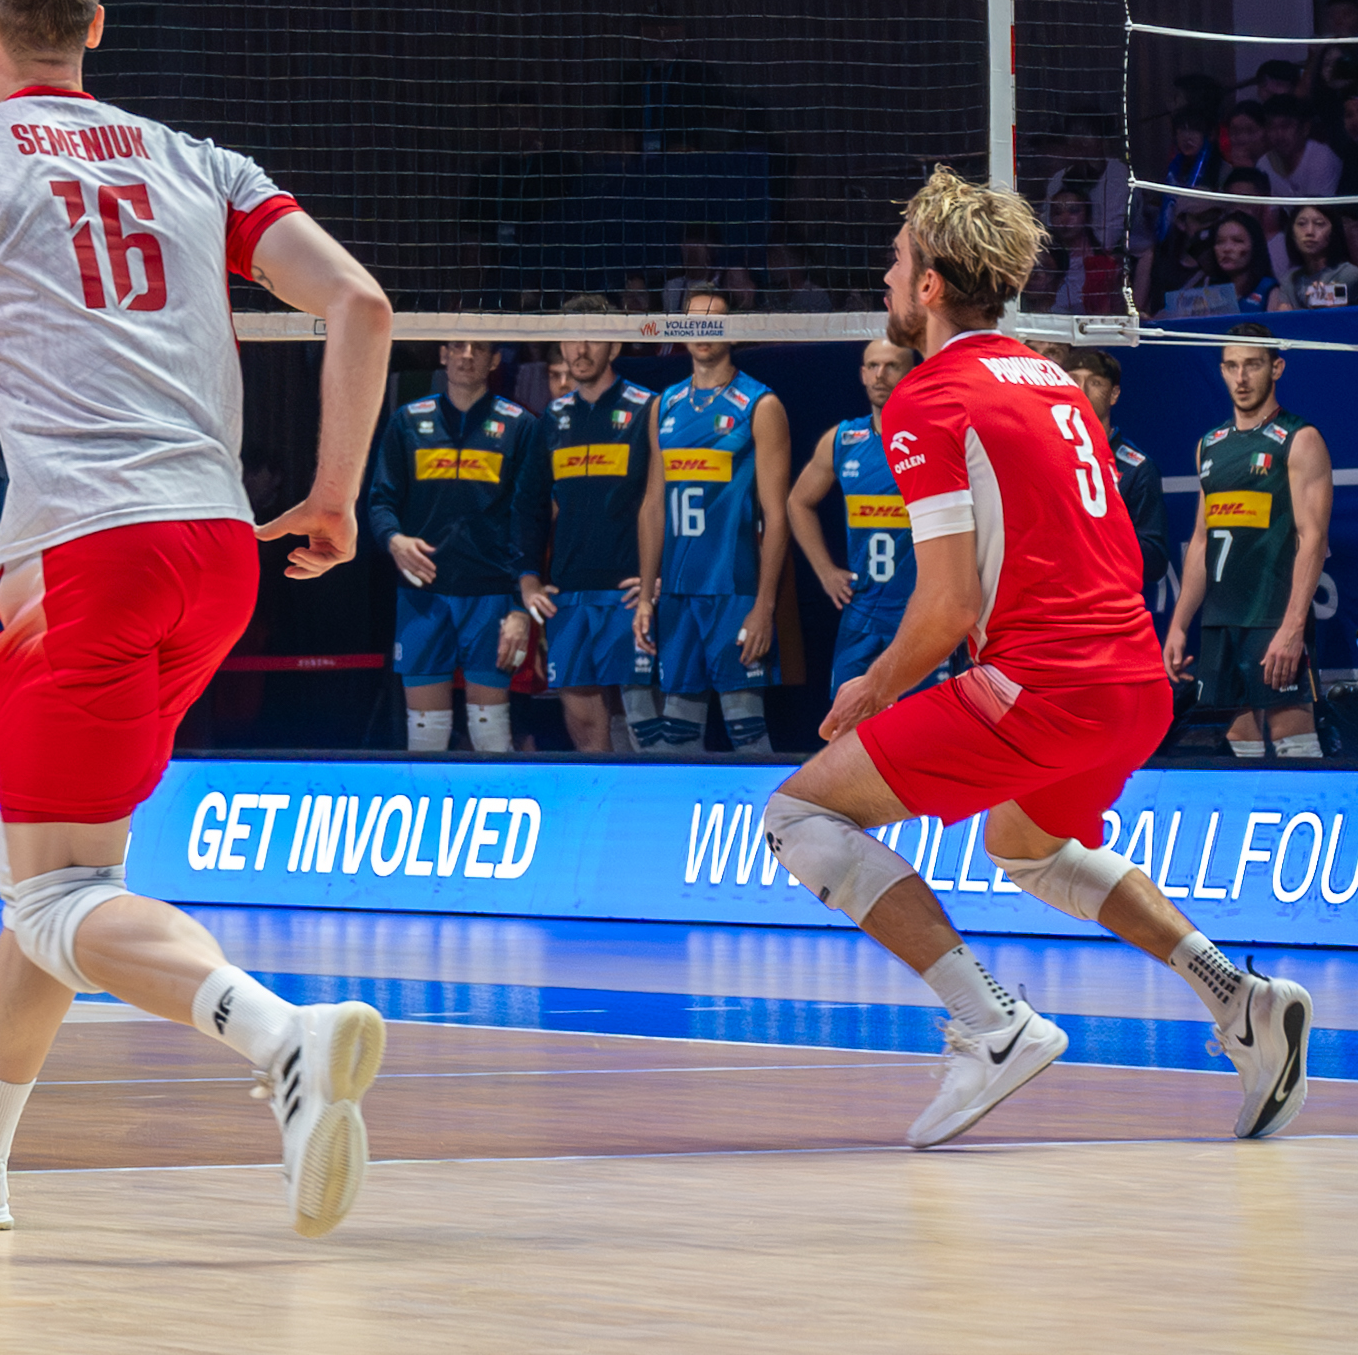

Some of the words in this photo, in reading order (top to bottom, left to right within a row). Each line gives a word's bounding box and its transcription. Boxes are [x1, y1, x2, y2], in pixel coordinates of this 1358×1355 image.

[11, 123, 152, 162] SEMENIUK
[49, 179, 168, 312] 16
[640, 320, 660, 336] VNL
[665, 320, 724, 329] VOLLEYBALL
[670, 459, 710, 470] DHL
[893, 453, 927, 475] ORLEN
[1050, 403, 1108, 518] 3
[670, 486, 706, 537] 16
[859, 505, 905, 518] DHL
[1209, 502, 1246, 516] DHL
[868, 532, 896, 583] 8
[1212, 529, 1233, 583] 7
[186, 791, 291, 872] GET
[287, 794, 543, 880] INVOLVED
